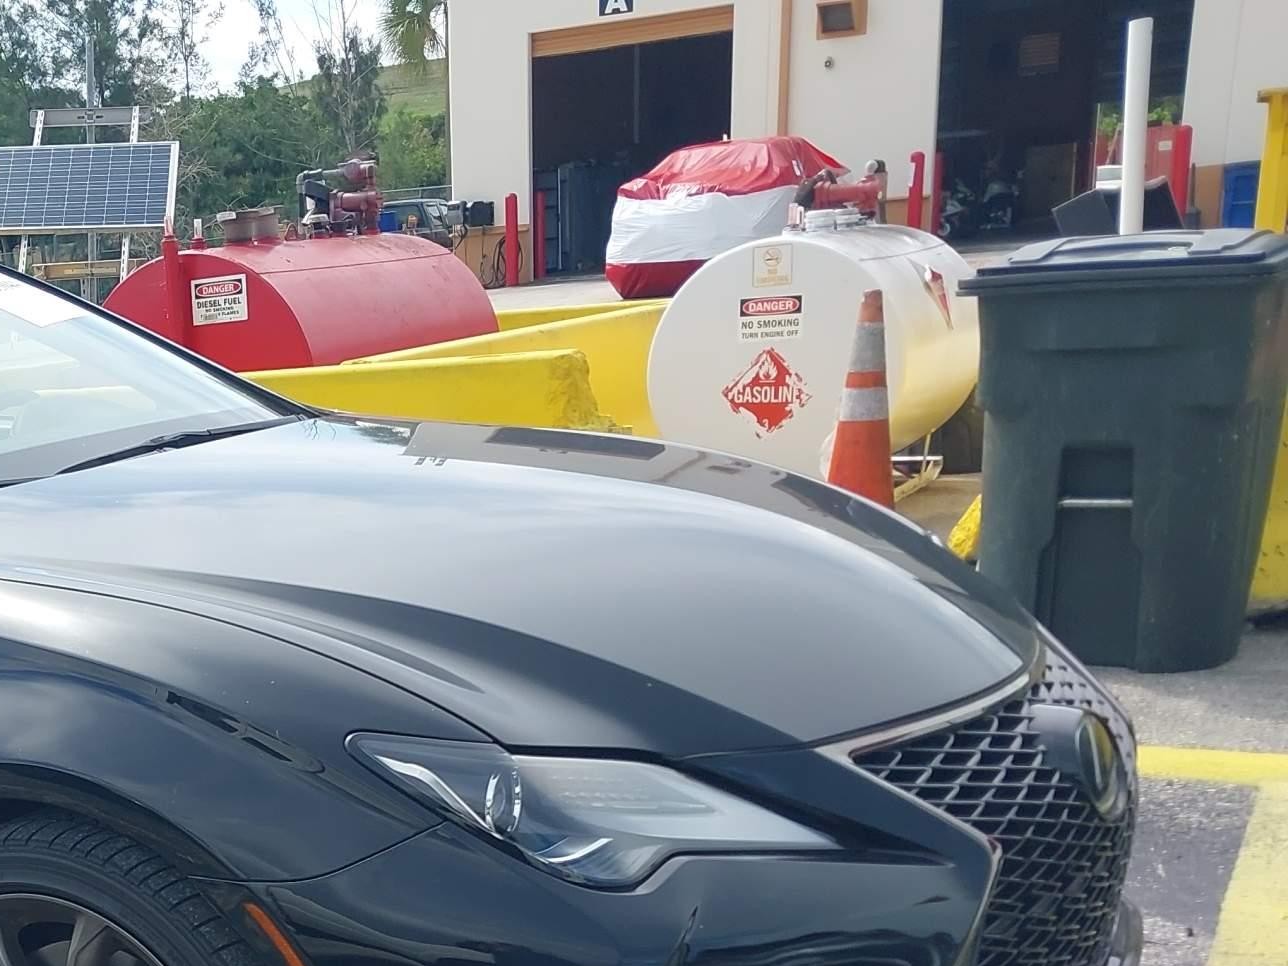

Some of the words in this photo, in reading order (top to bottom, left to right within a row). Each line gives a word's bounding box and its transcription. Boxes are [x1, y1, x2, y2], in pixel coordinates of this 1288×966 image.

[202, 283, 234, 295] DANGER
[196, 299, 222, 309] DIESEL
[223, 297, 242, 306] FUEL
[748, 300, 794, 312] DANGER
[741, 320, 754, 330] NO
[757, 318, 800, 329] SMOKING
[741, 332, 759, 340] TURN
[760, 330, 785, 339] ENGINE
[786, 329, 799, 337] OFF
[734, 385, 800, 404] GASOLINE
[762, 417, 770, 429] 3
